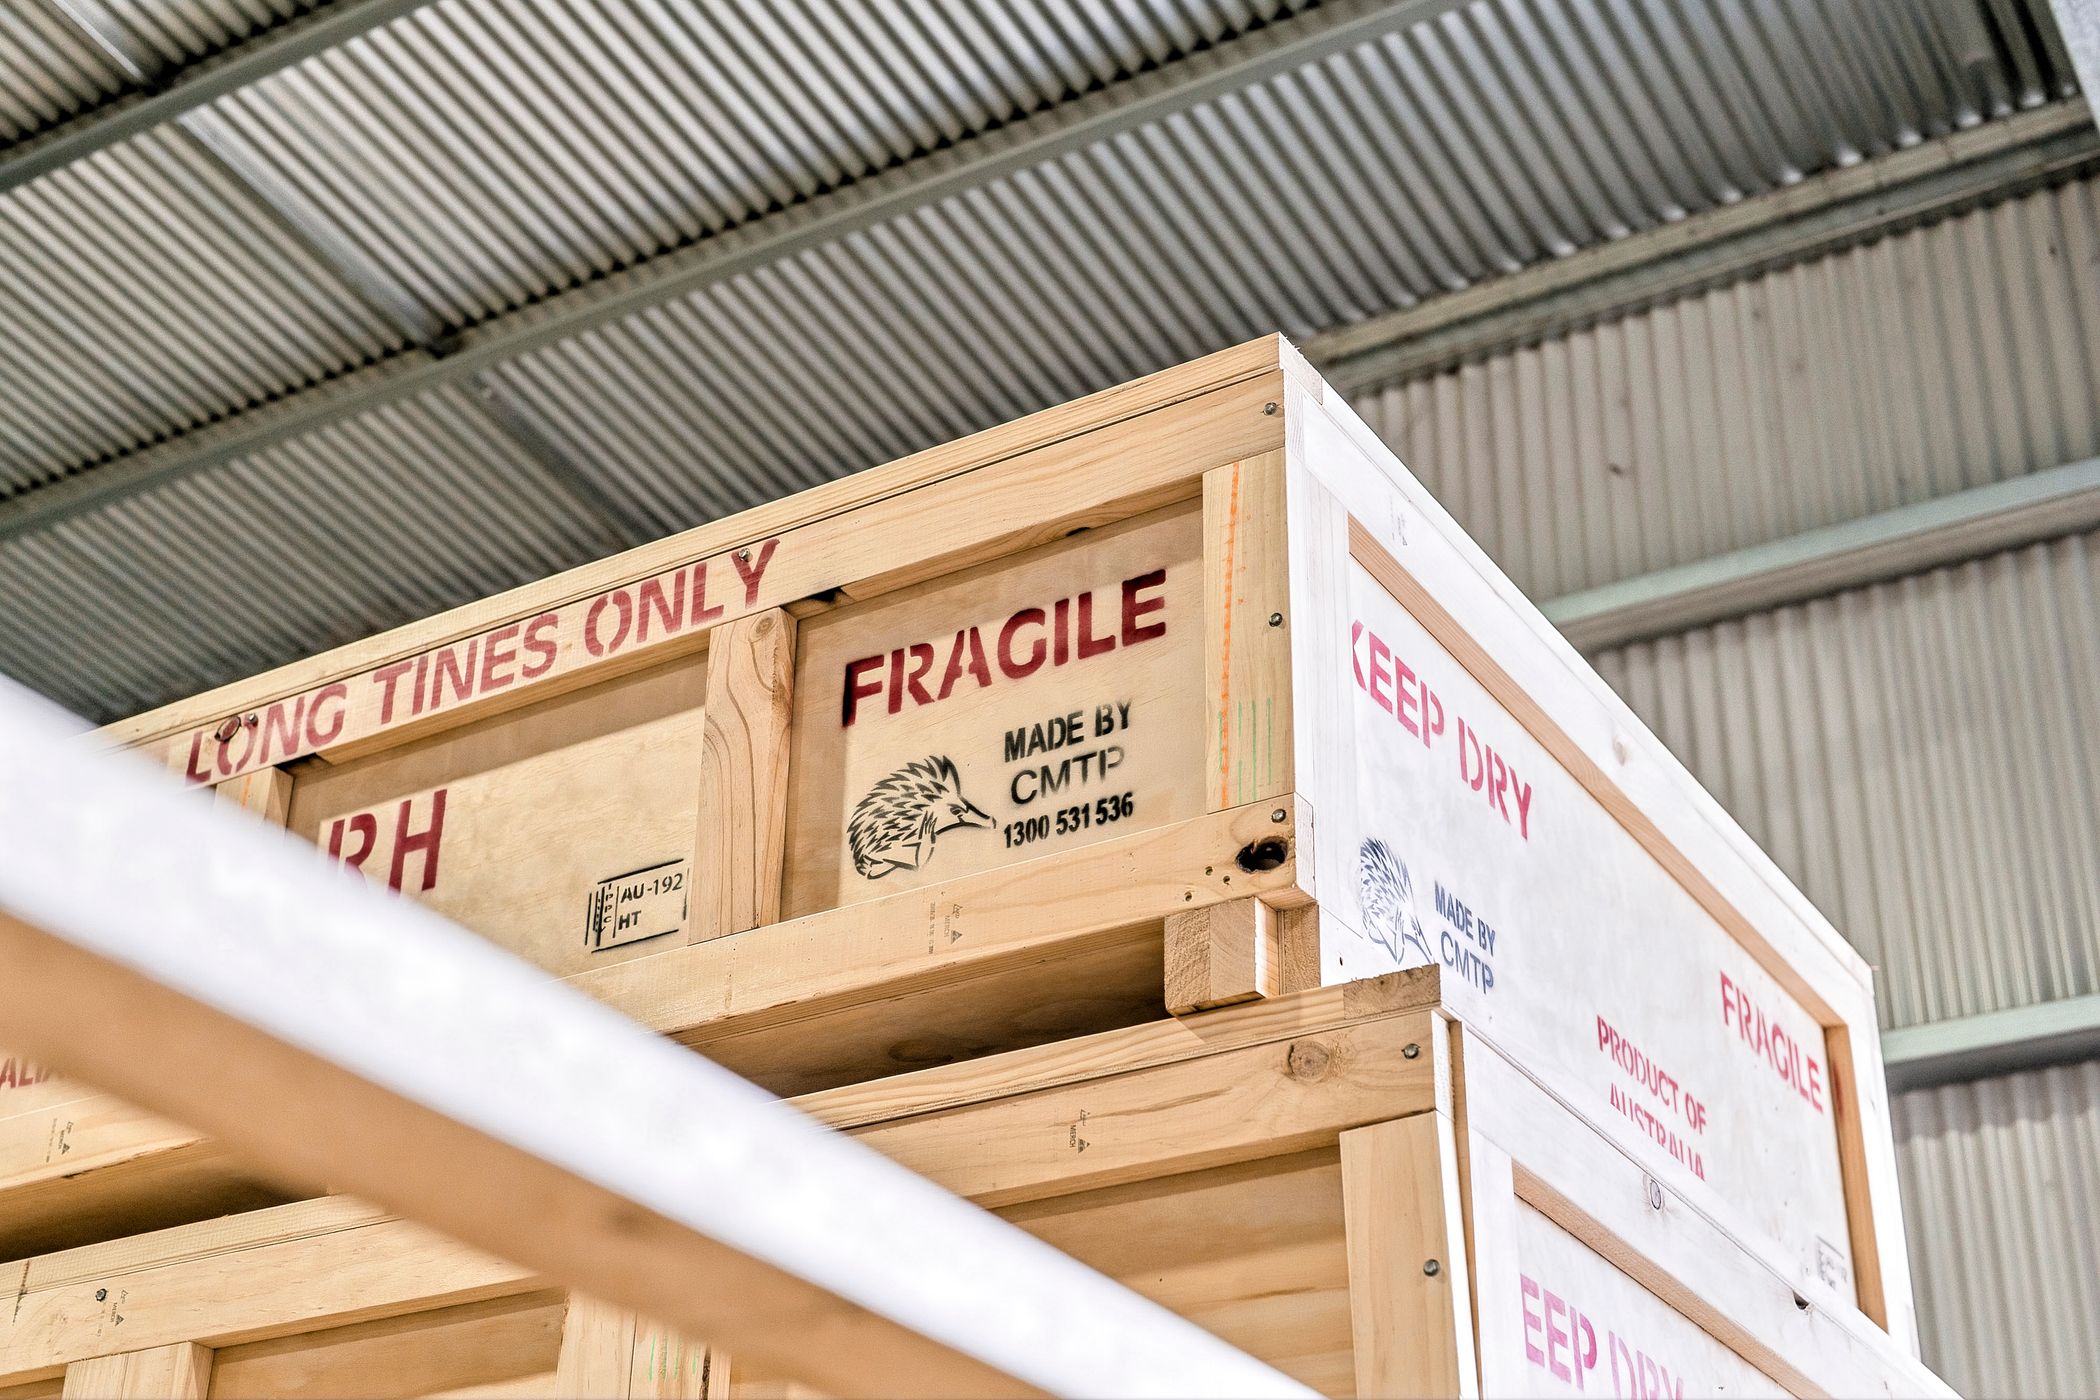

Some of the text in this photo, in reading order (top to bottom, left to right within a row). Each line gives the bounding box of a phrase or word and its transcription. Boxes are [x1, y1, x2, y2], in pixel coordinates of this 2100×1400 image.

[185, 539, 780, 786] LONG TINES ONLY
[842, 569, 1167, 728] FRAGILE
[1004, 699, 1132, 763] MADE BY
[1011, 745, 1125, 804] CMTP
[1458, 716, 1532, 840] DRY
[1004, 792, 1133, 848] 1300 531 536
[618, 910, 641, 930] HT
[620, 873, 683, 903] AU-192
[1434, 880, 1496, 957] MADE BY
[1441, 931, 1494, 995] CMTP
[1597, 1014, 1707, 1136] PRODUCT OF
[1720, 970, 1823, 1115] FRAGILE
